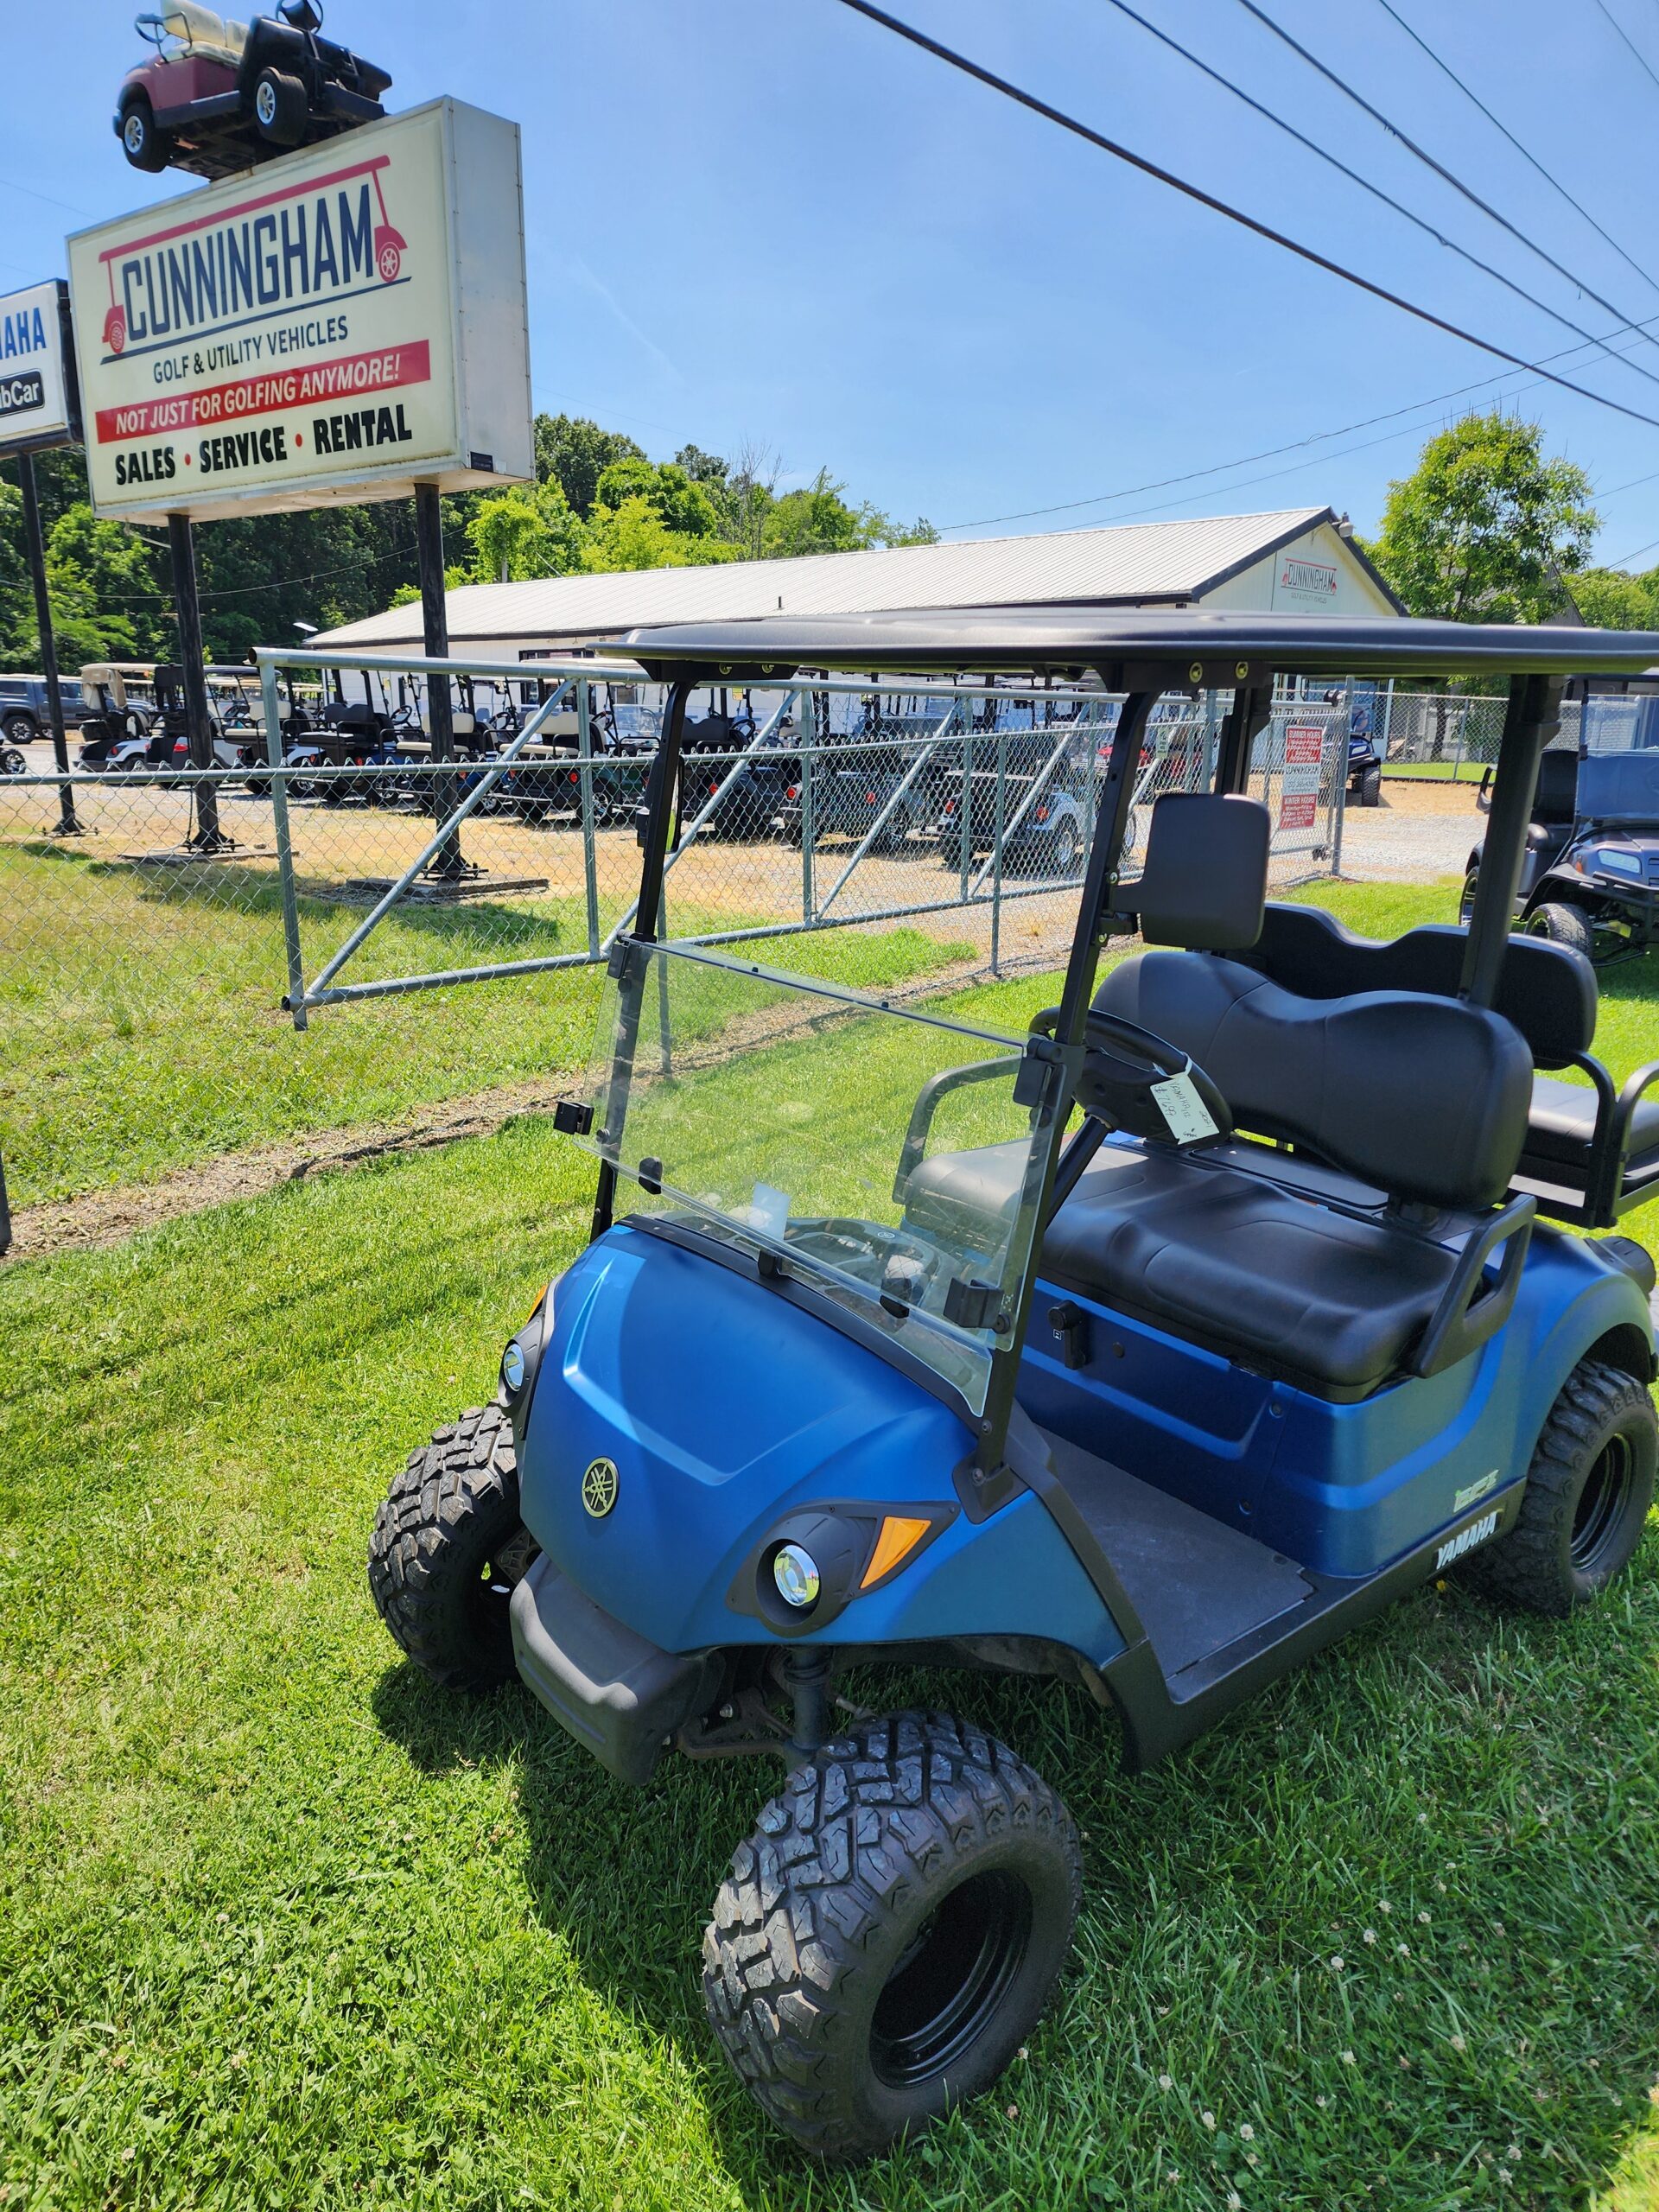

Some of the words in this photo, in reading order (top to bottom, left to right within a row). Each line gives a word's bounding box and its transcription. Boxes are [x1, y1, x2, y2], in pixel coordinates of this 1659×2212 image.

[122, 184, 373, 340] CUNNINGHAM
[0, 307, 47, 359] AHA
[154, 355, 188, 384] GOLF
[194, 353, 205, 374] &
[207, 335, 261, 369] UTILITY
[267, 315, 348, 355] VEHICLES
[0, 380, 40, 409] bCar
[116, 408, 148, 435] NOT
[150, 400, 189, 429] JUST
[192, 392, 221, 421] FOR
[224, 378, 296, 414] GOLFING
[300, 353, 400, 398] ANYMORE!
[115, 447, 175, 485] SALES
[200, 426, 288, 474] SERVICE
[313, 404, 412, 454] RENTAL
[1288, 563, 1334, 593] CUNNINGHAM
[1436, 1510, 1497, 1570] YAMAHA
